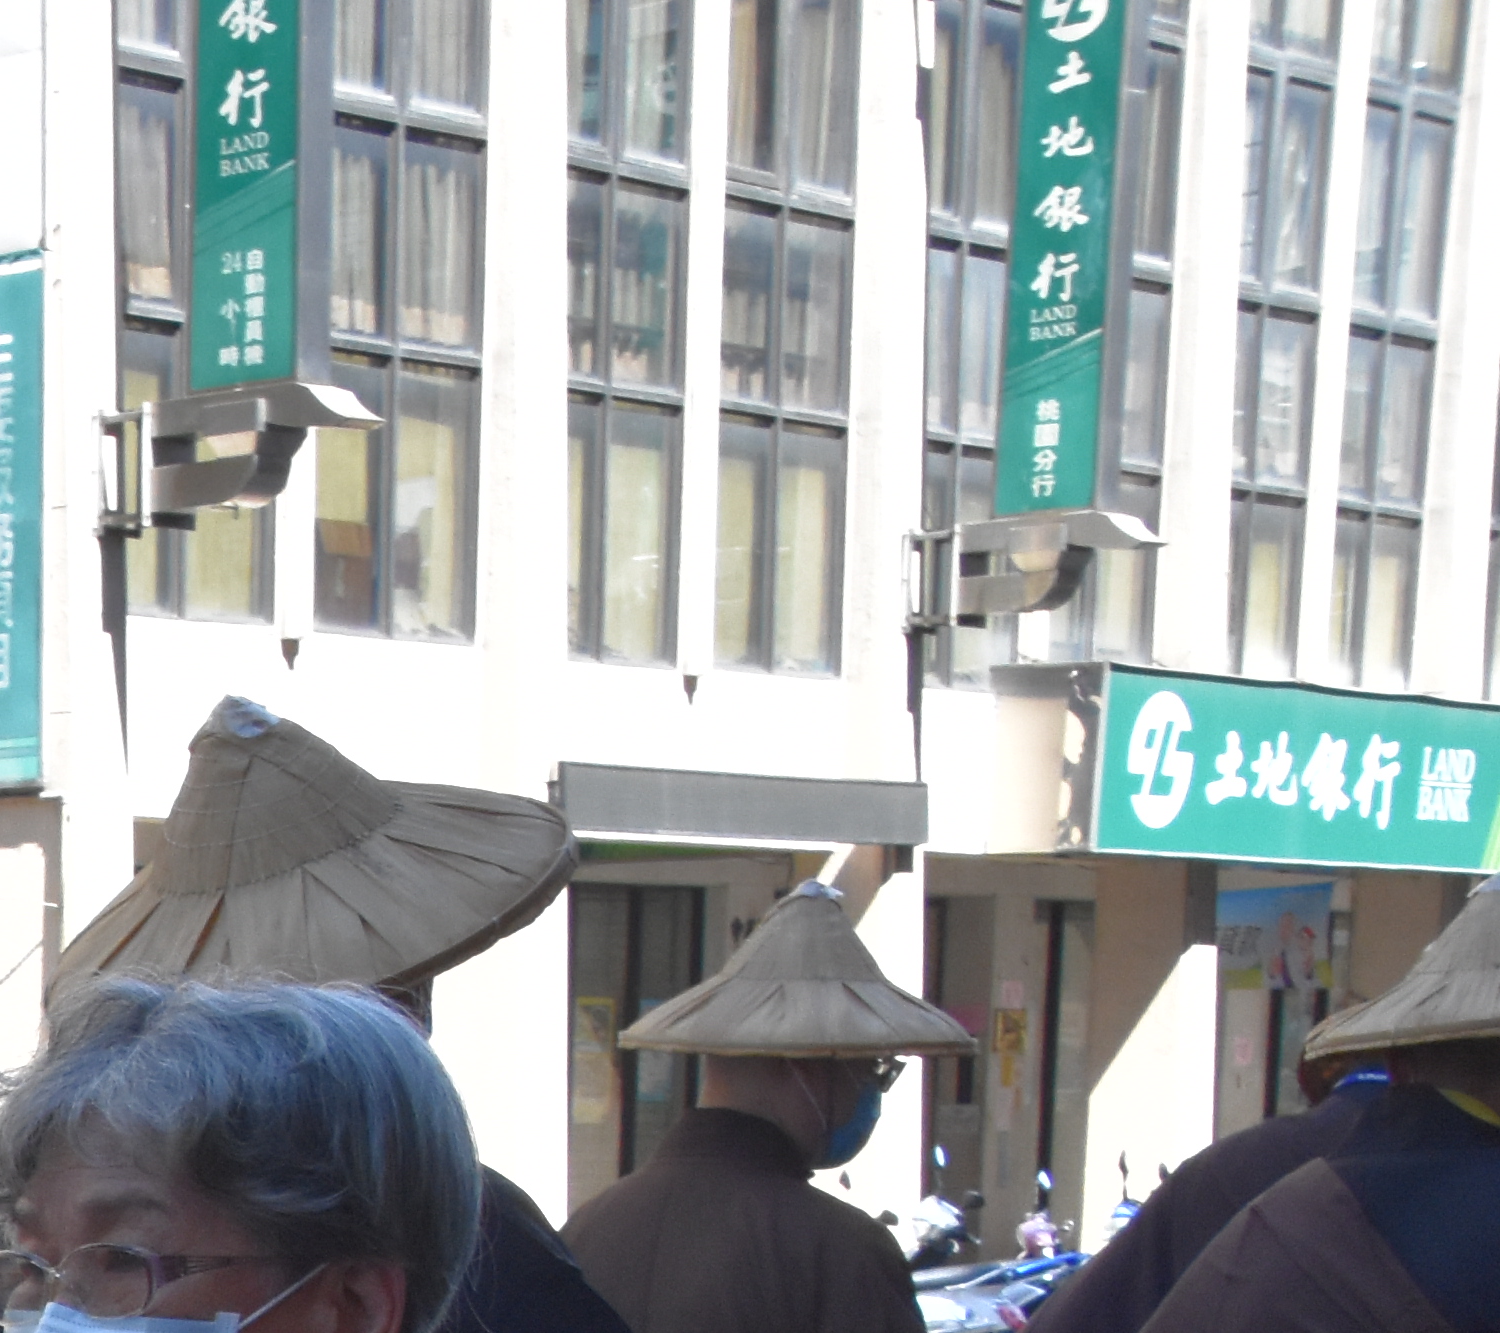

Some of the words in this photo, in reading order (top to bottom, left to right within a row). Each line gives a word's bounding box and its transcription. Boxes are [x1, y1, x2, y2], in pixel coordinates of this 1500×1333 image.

[218, 0, 277, 128] 銀行
[219, 131, 270, 155] LAND
[220, 152, 270, 177] BANK
[1030, 51, 1094, 302] 土地銀行
[1029, 321, 1077, 341] BANK
[1030, 304, 1077, 323] LAND
[1205, 730, 1401, 831] 土地銀行
[1422, 746, 1476, 783] LAND
[1416, 786, 1472, 822] BANK
